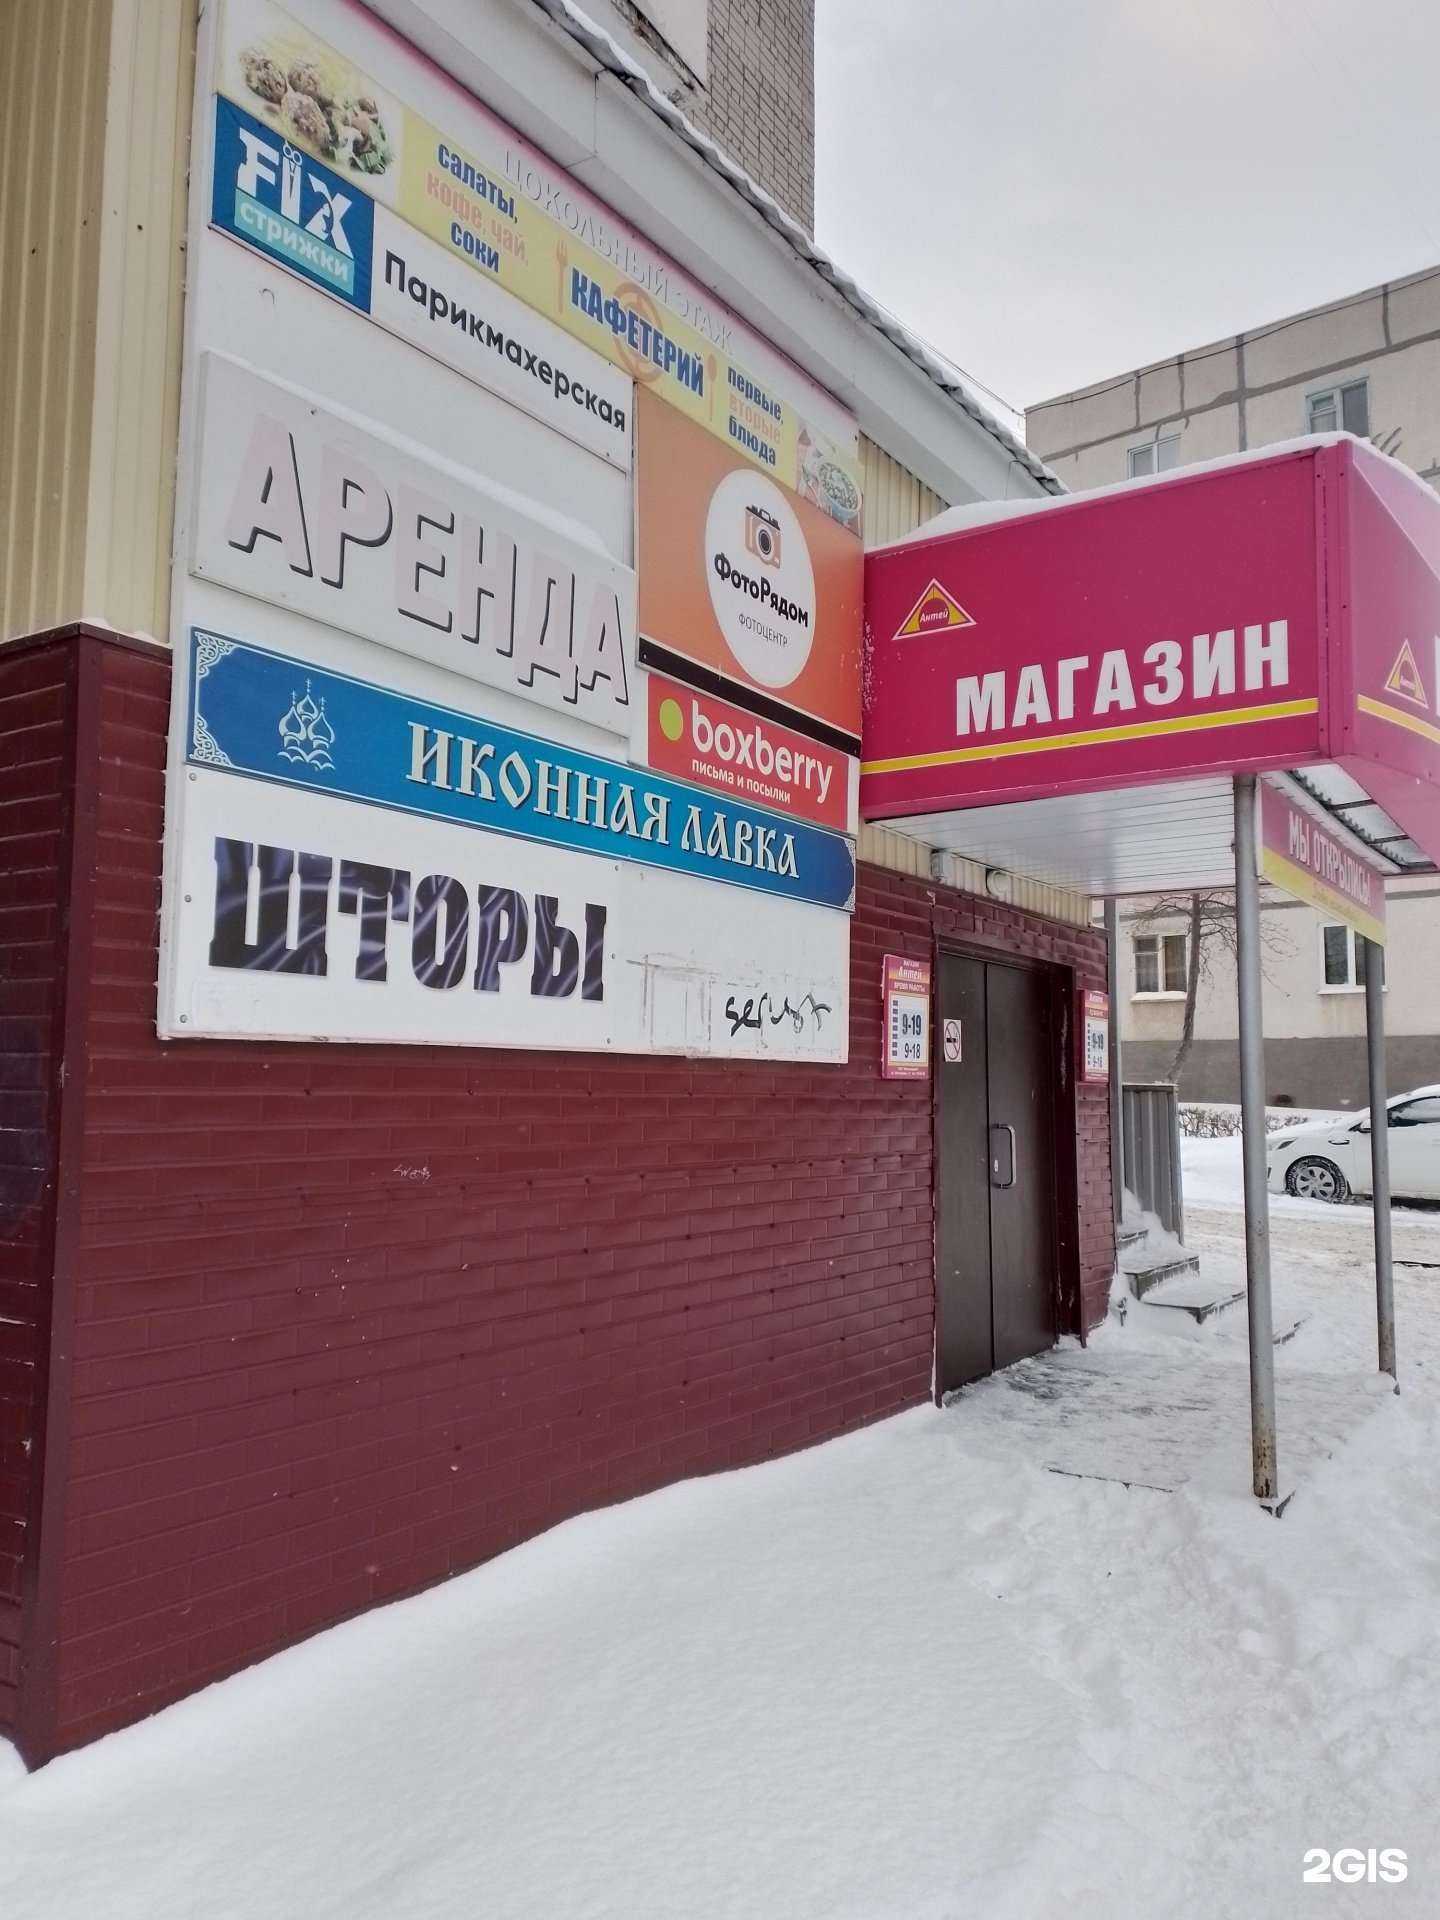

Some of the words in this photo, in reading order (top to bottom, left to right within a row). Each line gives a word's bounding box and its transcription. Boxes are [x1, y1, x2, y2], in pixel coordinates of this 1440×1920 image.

[438, 143, 518, 224] салаты,
[240, 202, 349, 280] стрижки
[450, 221, 499, 273] соки
[502, 148, 669, 305] ЦОКОЛЬНЫЙ
[385, 248, 626, 432] Парикмахерская
[571, 266, 705, 398] КАФЕТЕРИЙ
[727, 366, 784, 425] первые,
[729, 415, 776, 466] блюда
[222, 413, 630, 705] АРЕНДА
[713, 551, 809, 629] ФотоРядом
[738, 613, 789, 647] ФОТОЦЕНТР
[919, 608, 949, 624] Антей
[956, 619, 1289, 737] МАГАЗИН
[691, 700, 833, 804] boxberry
[691, 759, 735, 785] письма
[736, 774, 744, 788] и
[746, 779, 791, 804] посылки
[406, 719, 670, 846] ИКОННАЯ
[681, 803, 800, 881] ЛАВКА
[1288, 810, 1311, 867] МЫ
[208, 836, 608, 1001] ШТОРЫ
[902, 1014, 922, 1036] 9-19
[904, 1043, 921, 1059] 9-18
